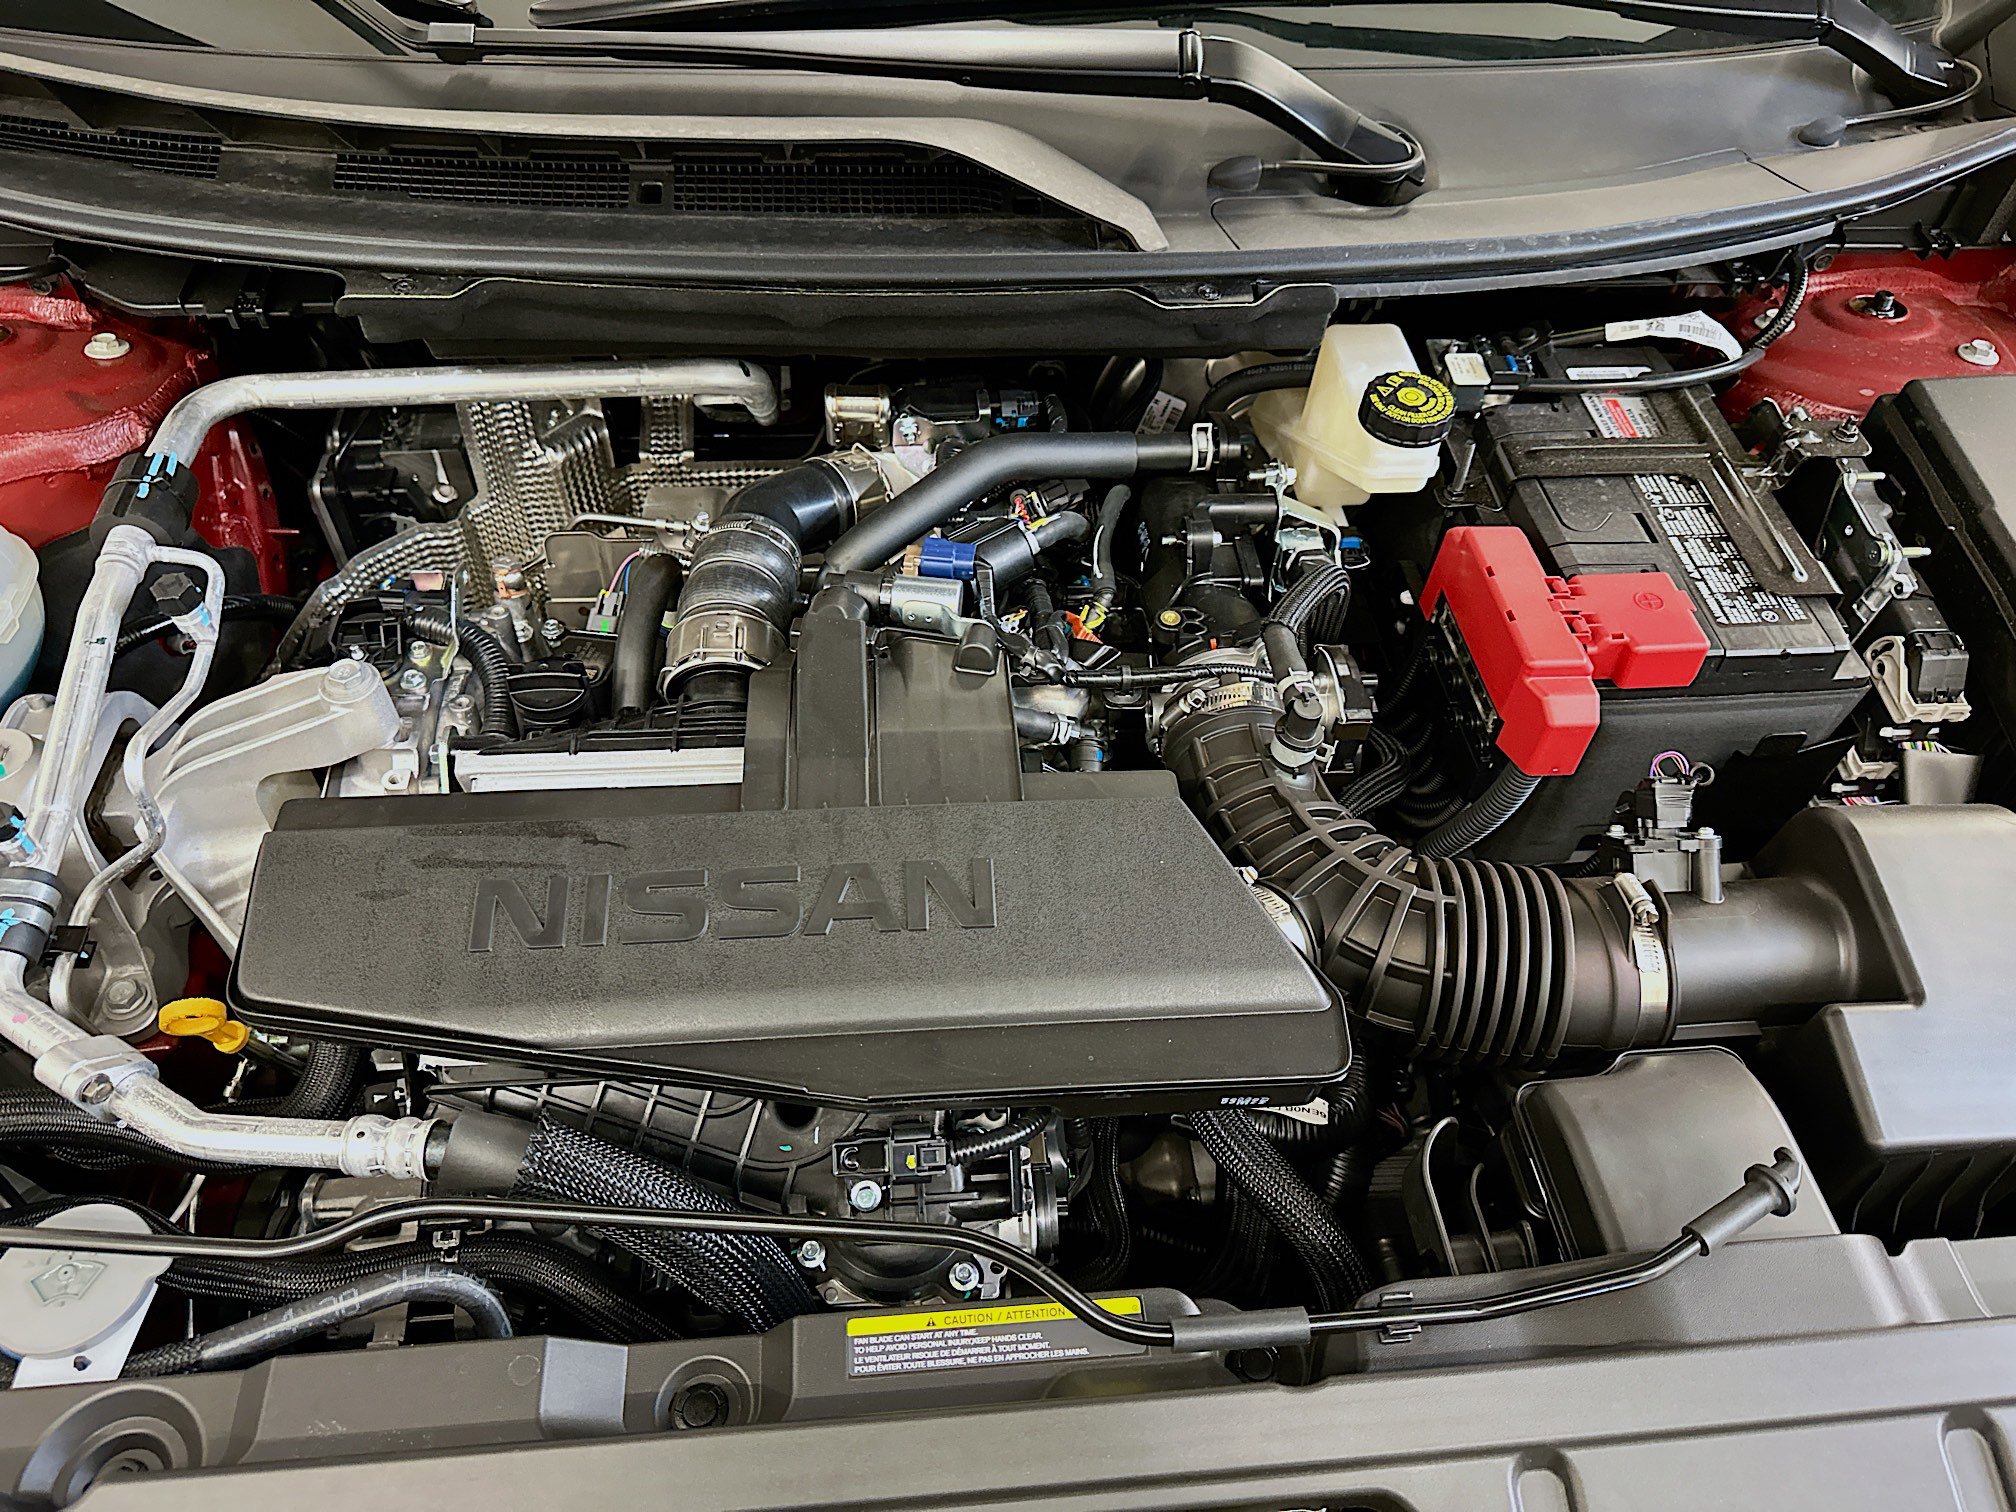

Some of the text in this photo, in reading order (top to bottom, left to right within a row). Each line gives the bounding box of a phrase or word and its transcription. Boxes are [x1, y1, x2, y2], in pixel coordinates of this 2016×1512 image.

[468, 857, 998, 953] NISSAN
[944, 1313, 993, 1325] CAUTION
[1006, 1308, 1066, 1320] ATTENTION
[854, 1328, 979, 1345] FAN BLADE CAN START AT ANY TIME.
[854, 1346, 864, 1354] TO
[866, 1344, 885, 1353] HELP
[885, 1343, 908, 1352] AVOID
[908, 1340, 948, 1350] PERSONAL
[992, 1334, 1018, 1343] HANDS
[1018, 1332, 1043, 1341] CLEAR.
[854, 1356, 863, 1365] LE
[863, 1352, 911, 1364] VENTILATEUR
[912, 1350, 940, 1360] RISQUE
[940, 1349, 951, 1358] DE
[951, 1346, 991, 1357] DÉMARRER
[998, 1343, 1018, 1352] TOUT
[1018, 1341, 1051, 1351] MOMENT.
[854, 1347, 1090, 1374] POUR ÉVITER TOUTE BLESSURE, NE PAS EN APPROCHER LES MAINS.
